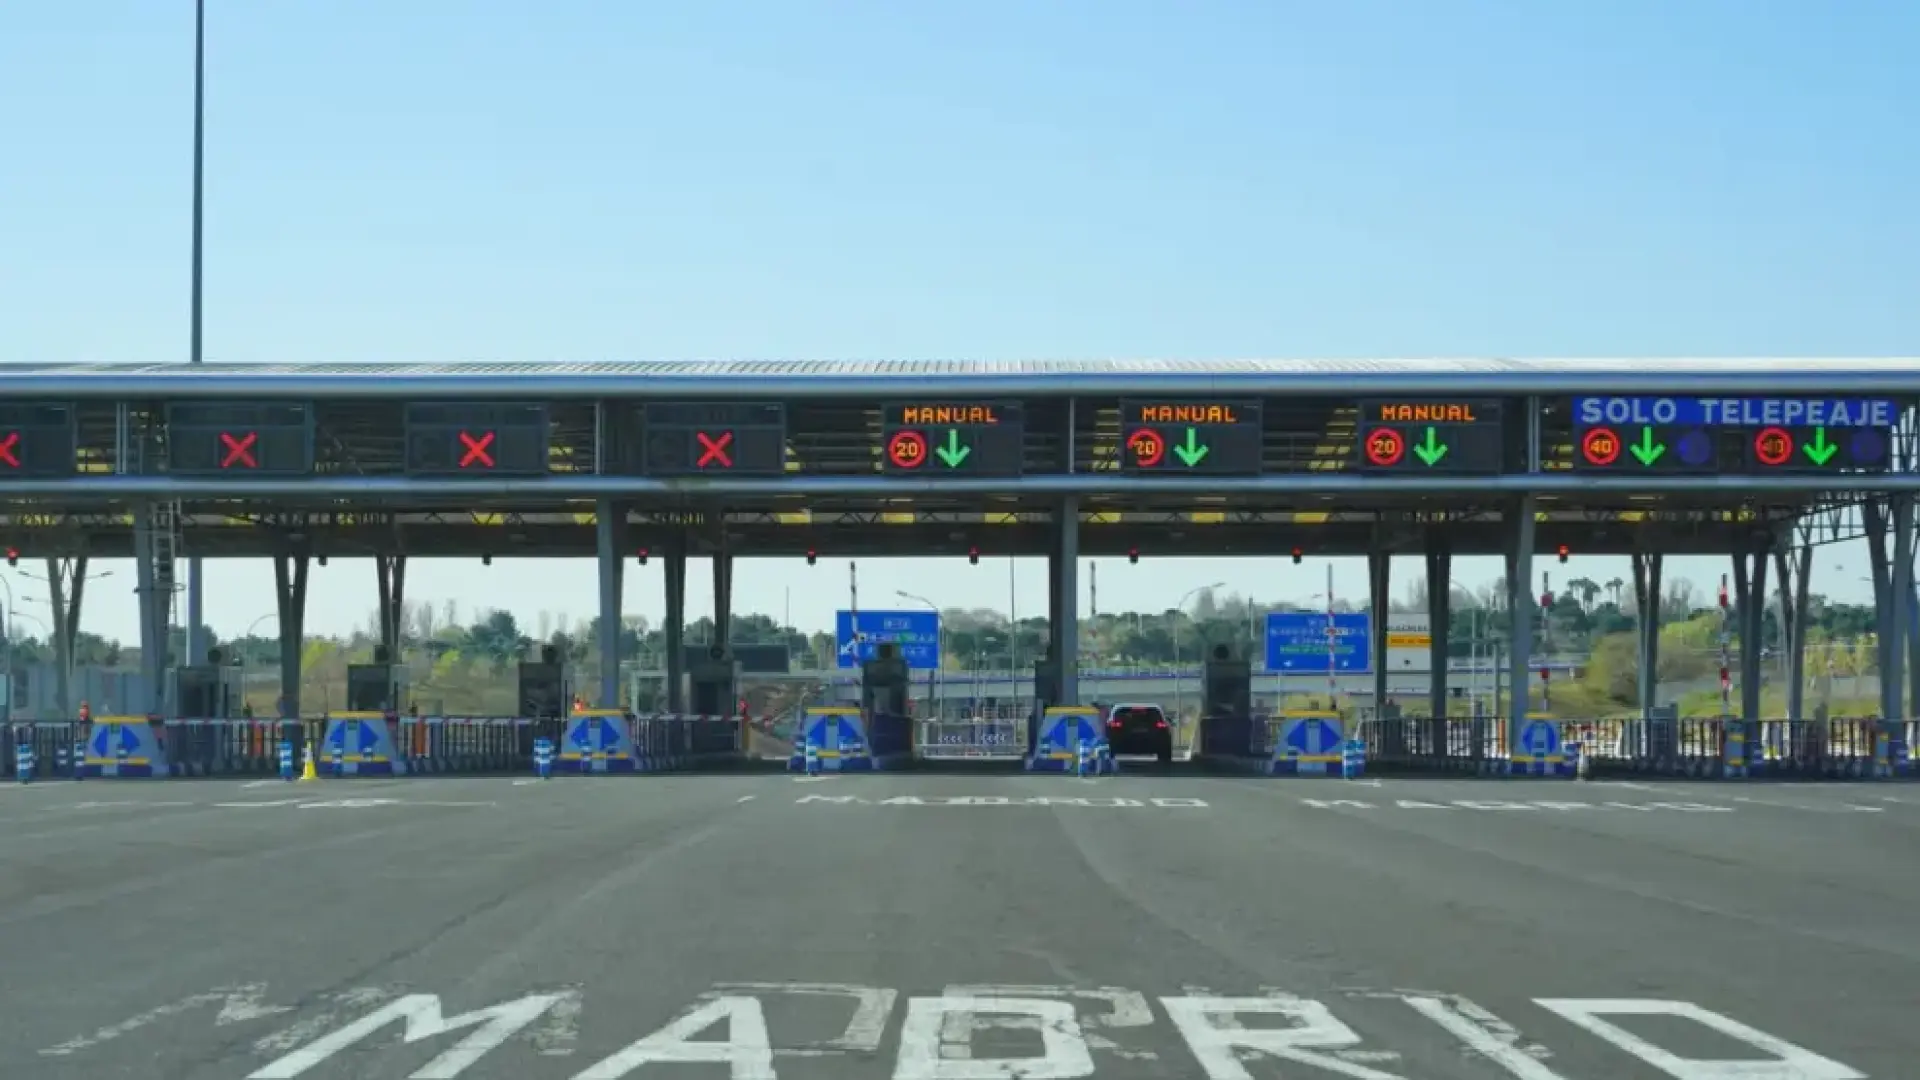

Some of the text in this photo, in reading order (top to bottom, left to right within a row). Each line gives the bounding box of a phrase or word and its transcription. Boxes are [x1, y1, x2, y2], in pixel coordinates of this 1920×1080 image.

[904, 407, 998, 423] MANUAL
[1143, 406, 1236, 422] MANUAL
[1382, 404, 1475, 421] MANUAL
[1581, 398, 1889, 427] SOLO TELEPEAJE
[896, 441, 919, 458] 20
[1133, 440, 1155, 456] 20
[1373, 439, 1396, 455] 20
[1589, 439, 1612, 454] 40
[246, 992, 1869, 1080] MADRID
